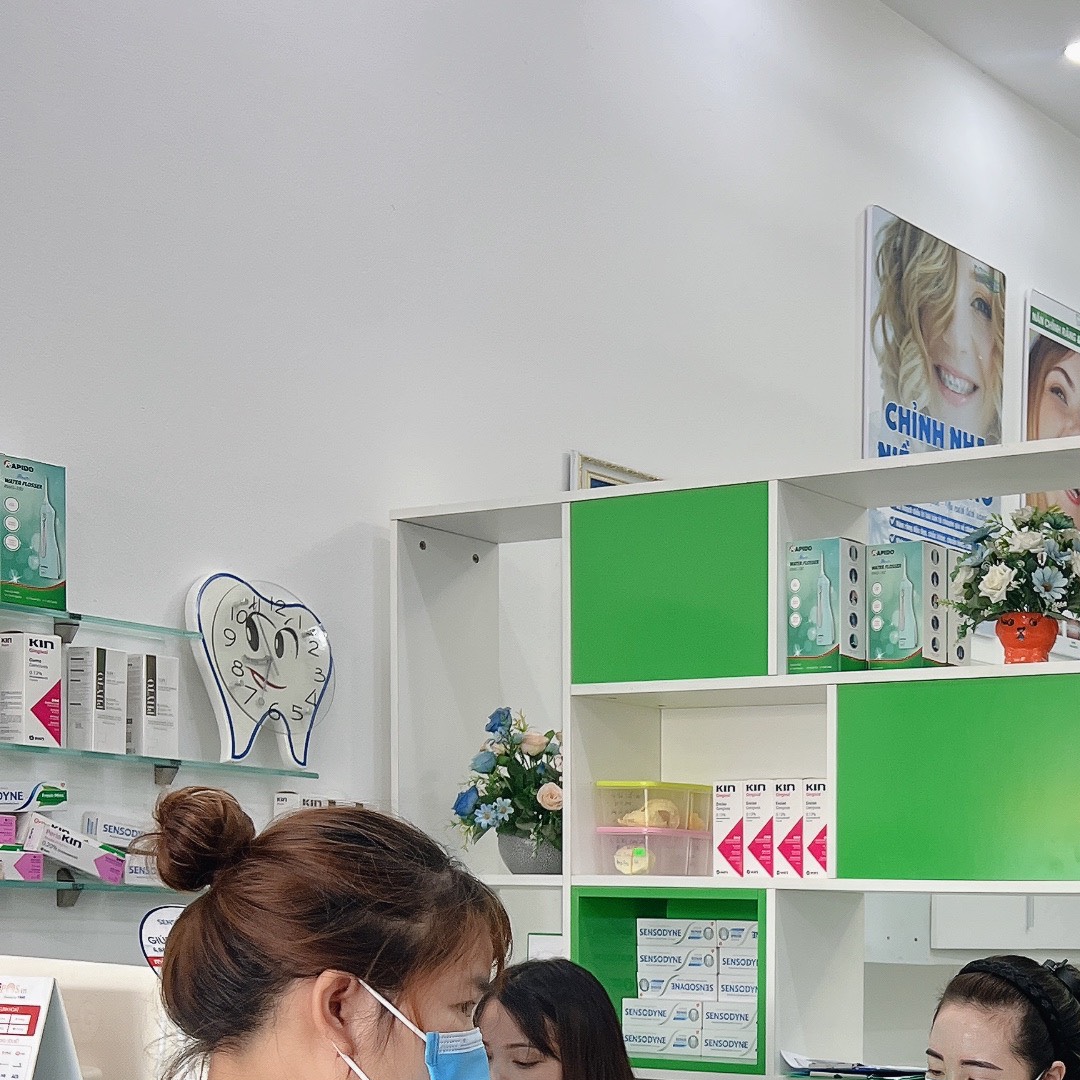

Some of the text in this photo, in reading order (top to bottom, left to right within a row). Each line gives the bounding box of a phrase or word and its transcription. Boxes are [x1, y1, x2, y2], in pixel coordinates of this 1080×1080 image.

[885, 401, 945, 449] CHỈNH
[270, 596, 286, 617] 12
[231, 606, 248, 624] 10
[29, 638, 54, 649] KIN
[223, 628, 237, 647] 9
[308, 640, 320, 657] 2
[231, 660, 244, 677] 8
[314, 667, 326, 683] 3
[244, 685, 258, 705] 7
[304, 689, 317, 707] 4
[268, 702, 281, 721] 6
[291, 704, 304, 721] 5
[147, 935, 168, 945] GIÚ
[639, 928, 682, 937] SENSODYNE
[639, 954, 682, 964] SENSODYNE
[722, 957, 758, 967] SENSODY
[720, 984, 758, 993] SENSODYN
[624, 1008, 667, 1018] SENSODYNE
[705, 1011, 750, 1022] SENSODYNE
[623, 1035, 666, 1045] SENSODYNE
[704, 1038, 749, 1049] SENSODYNE
